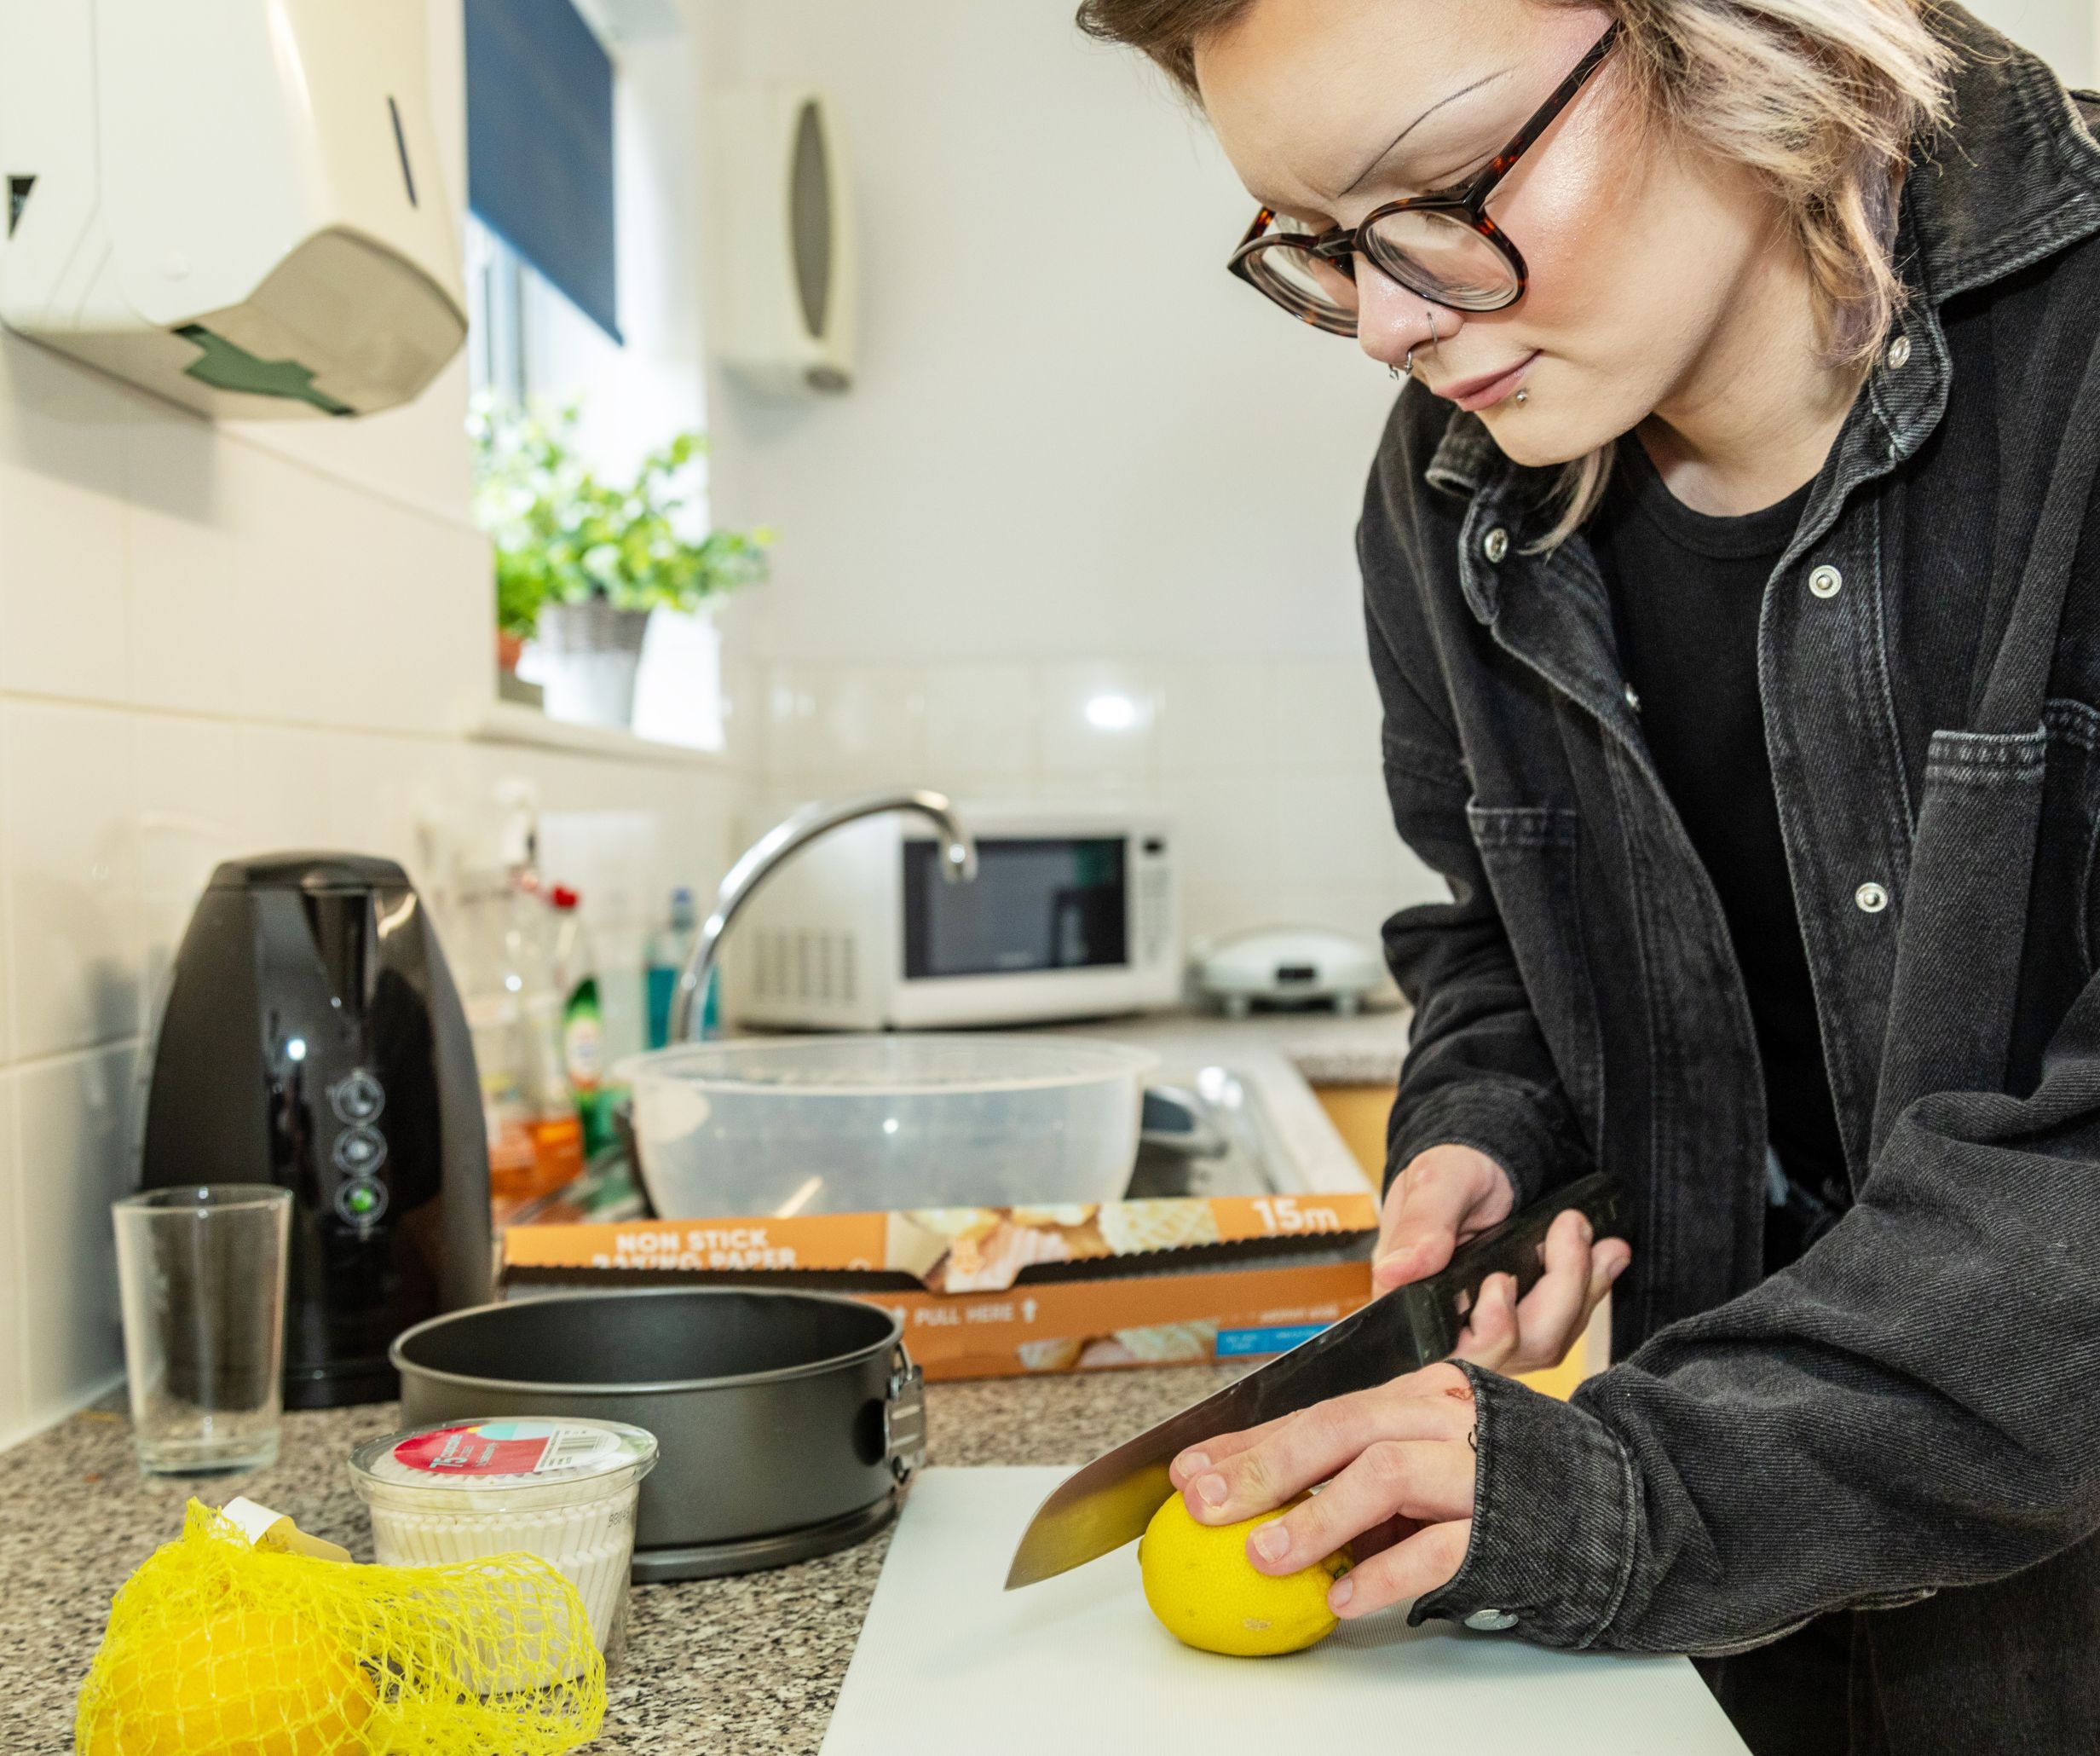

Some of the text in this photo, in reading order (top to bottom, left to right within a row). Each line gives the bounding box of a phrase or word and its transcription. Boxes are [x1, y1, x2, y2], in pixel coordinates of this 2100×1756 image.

[1252, 1199, 1341, 1237] 15m
[616, 1227, 769, 1254] NON STICK
[708, 1247, 797, 1271] PAPER
[914, 1302, 1014, 1327] PULL HERE
